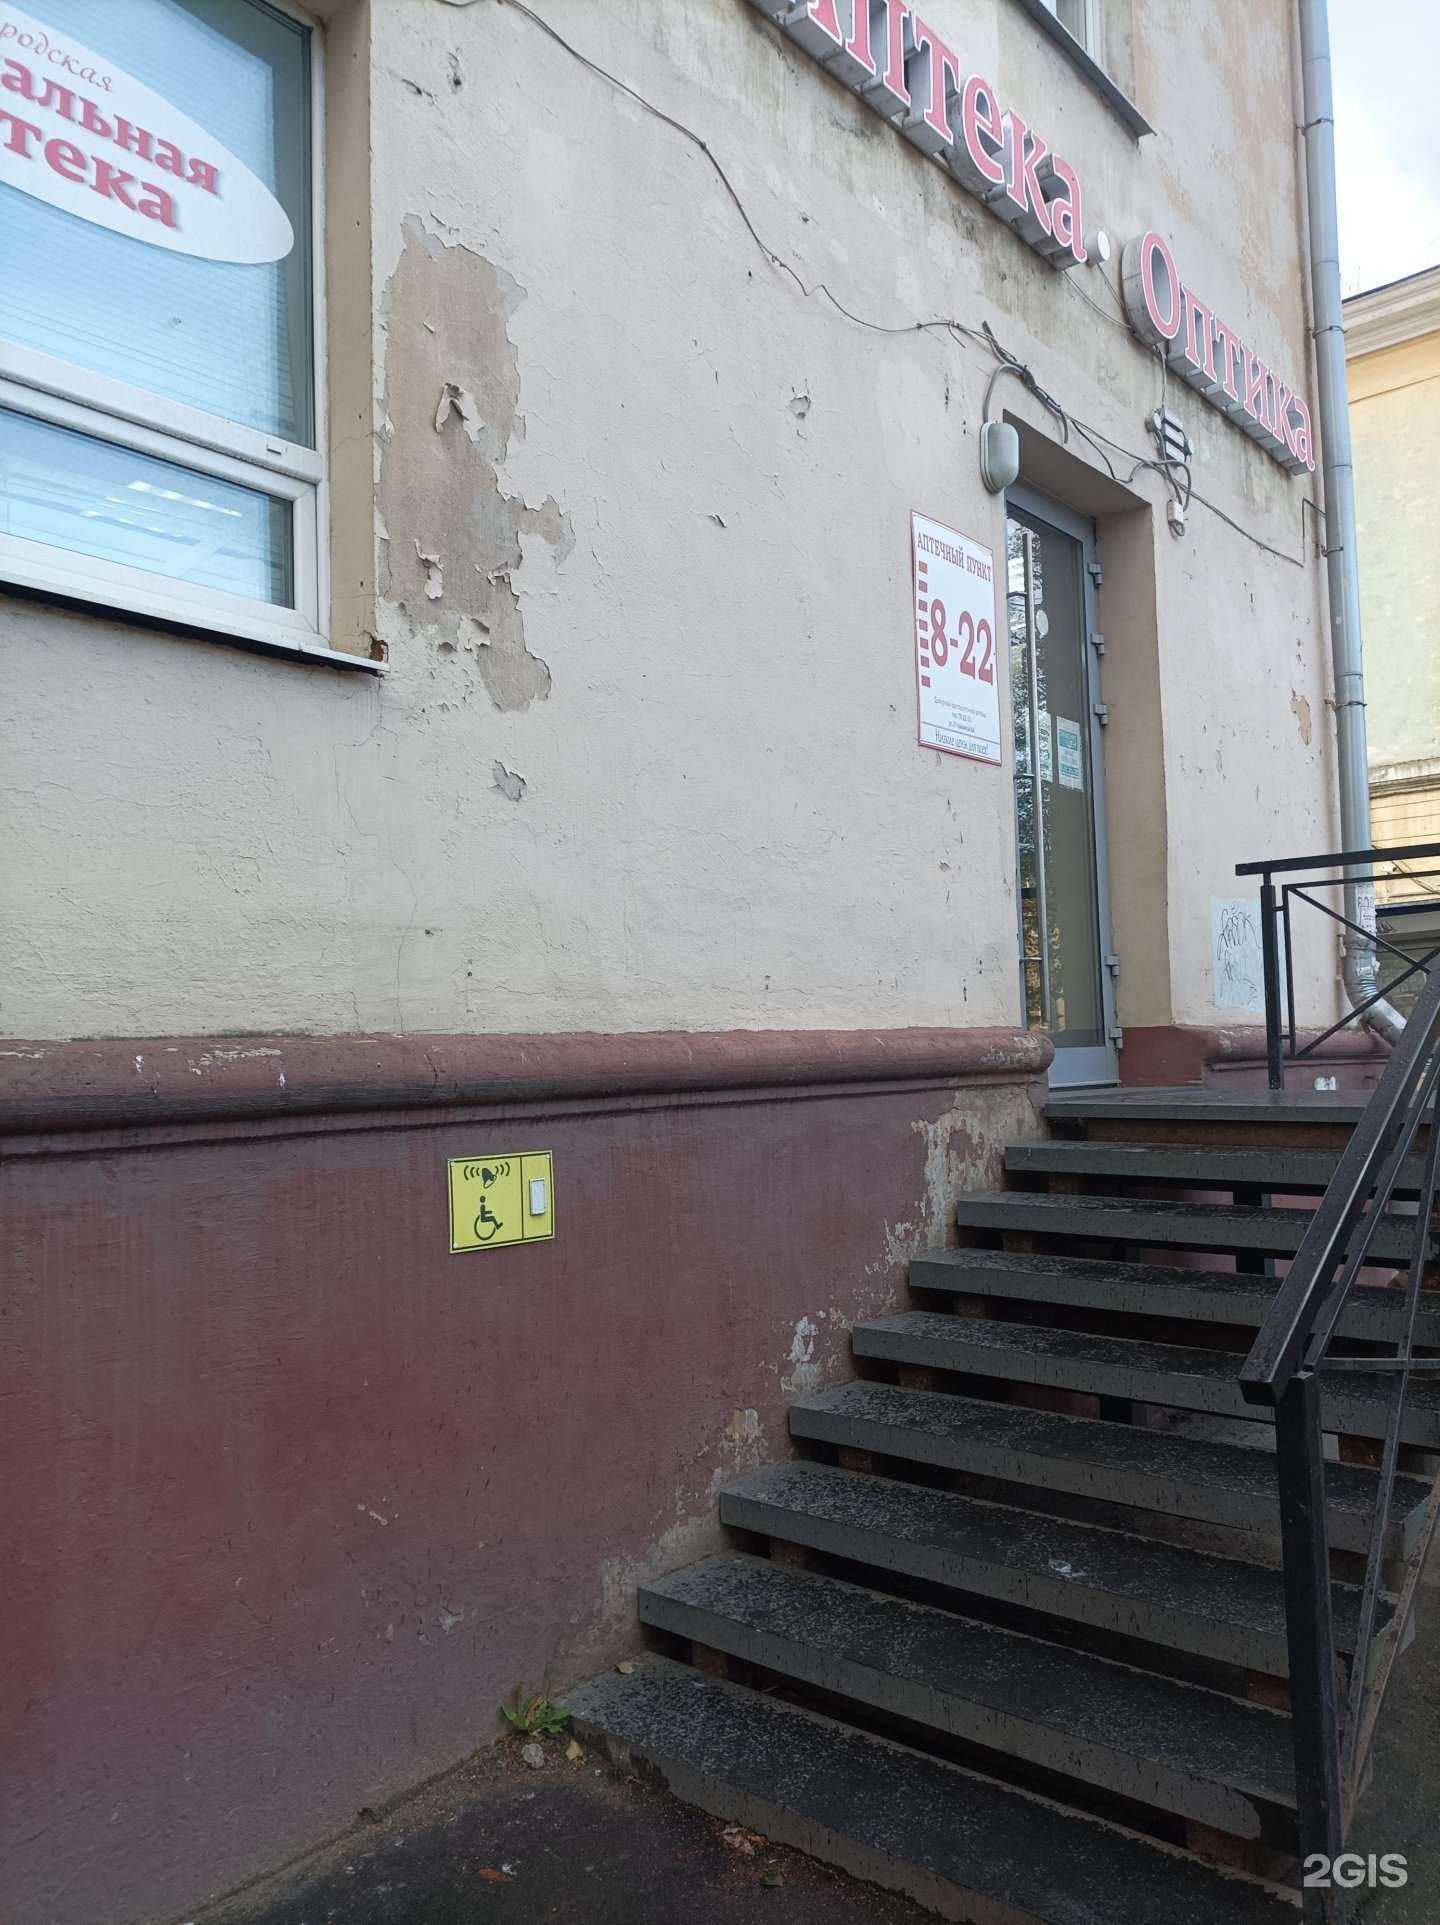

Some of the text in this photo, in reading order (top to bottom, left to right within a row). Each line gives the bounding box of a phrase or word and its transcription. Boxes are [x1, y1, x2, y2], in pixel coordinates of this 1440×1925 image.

[0, 57, 219, 196] альная
[790, 0, 1087, 263] птека
[1141, 230, 1316, 472] Оптика
[917, 531, 992, 583] АПТЕЧНЫЙ ПУНКТ
[930, 598, 994, 686] 8-22
